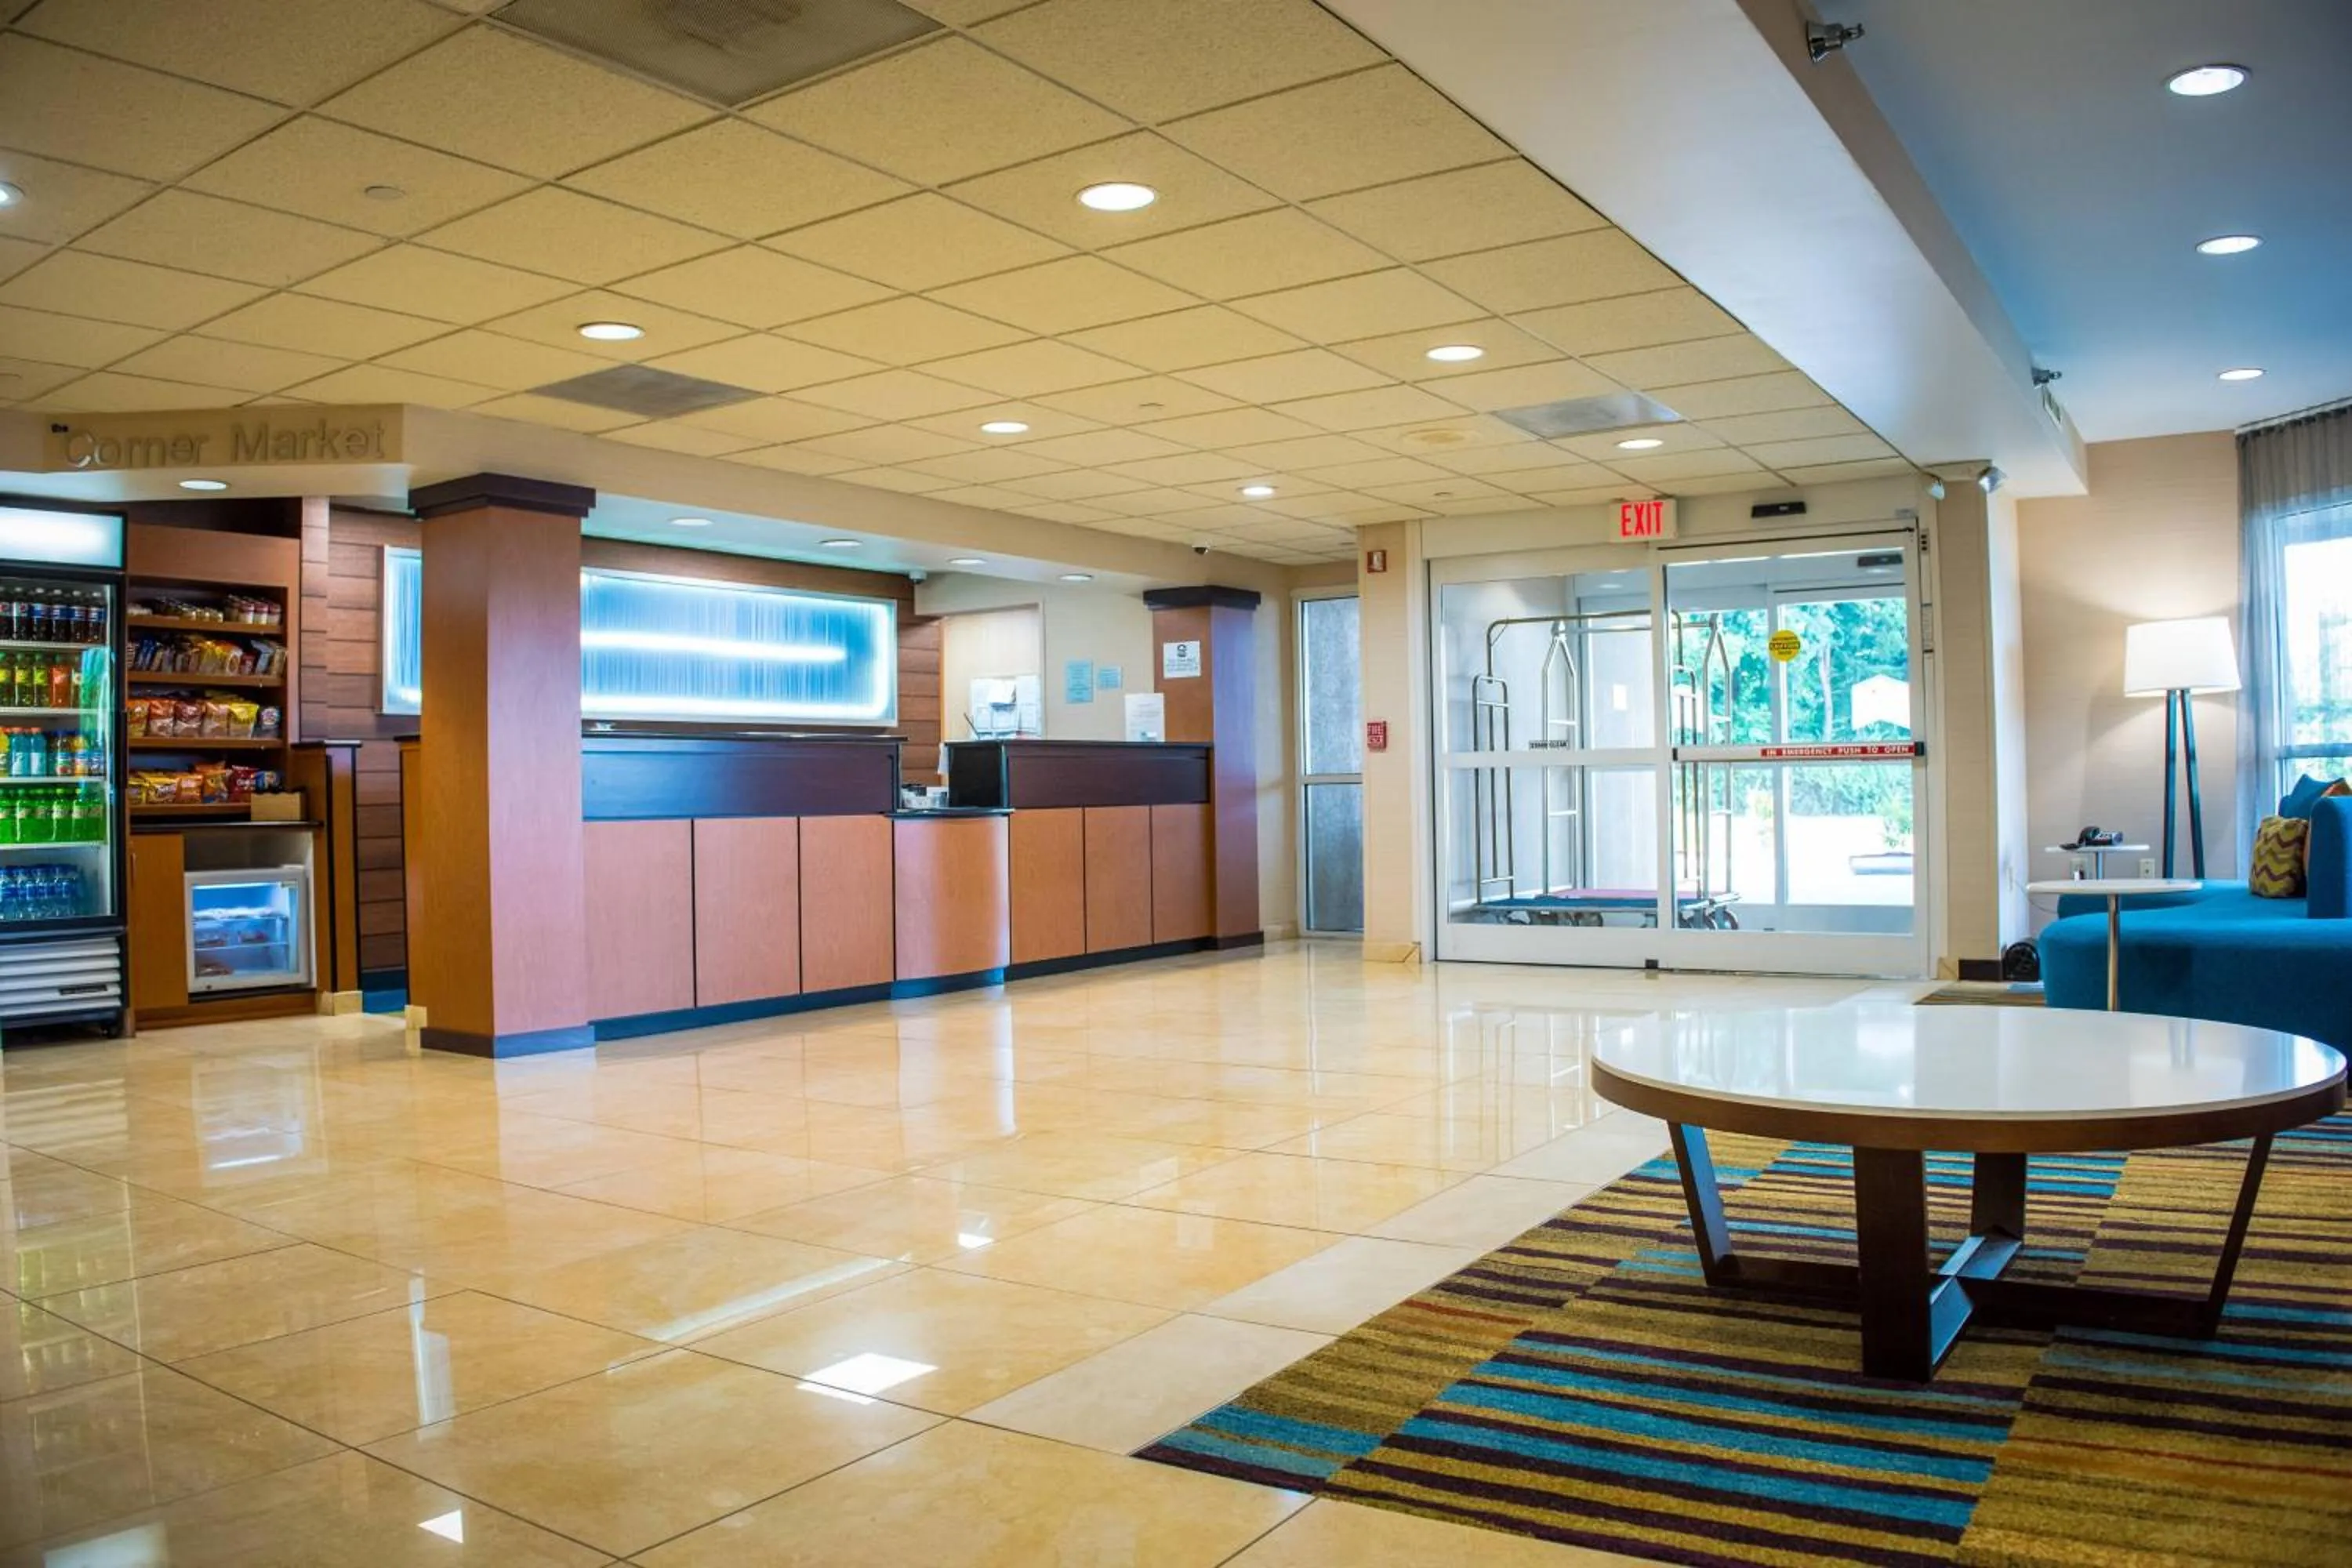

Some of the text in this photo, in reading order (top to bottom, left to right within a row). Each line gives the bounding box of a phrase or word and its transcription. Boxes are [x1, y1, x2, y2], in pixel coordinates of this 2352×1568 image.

[66, 417, 386, 468] Corner Market
[1620, 501, 1663, 537] EXIT
[1766, 745, 1909, 757] IN EMERGENCY PUSH TO OPEN
